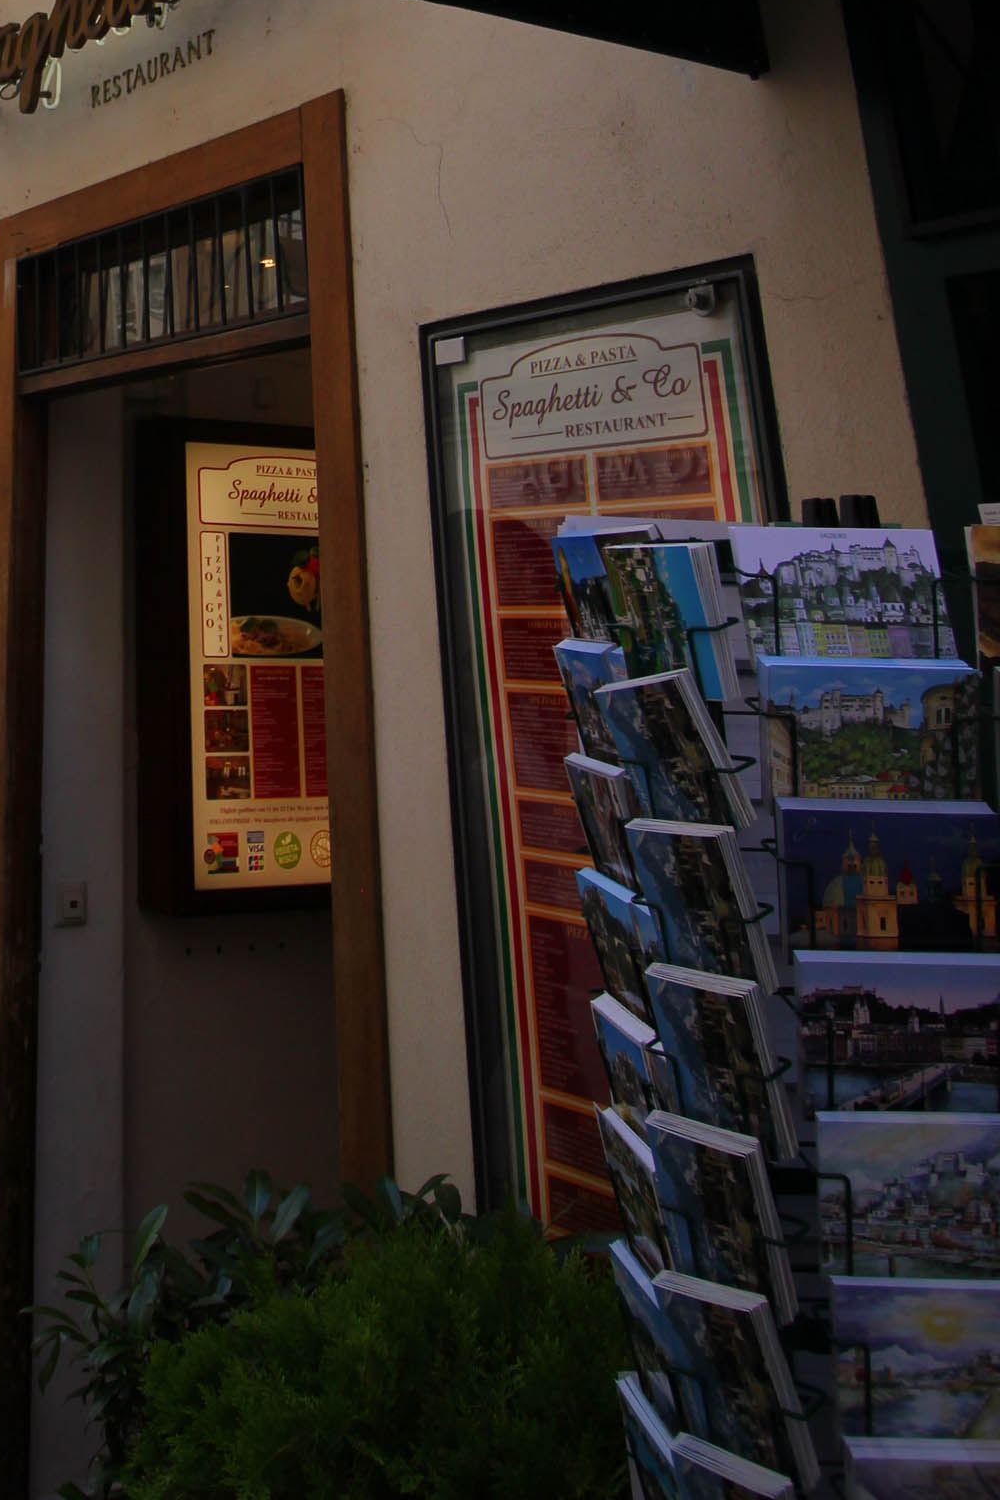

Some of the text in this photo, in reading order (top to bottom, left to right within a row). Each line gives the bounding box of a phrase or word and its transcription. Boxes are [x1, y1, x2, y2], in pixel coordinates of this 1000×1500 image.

[90, 29, 216, 109] RESTAURANT
[529, 345, 637, 375] PIZZA & PASTA
[492, 364, 692, 429] Spaghetti & Co
[564, 412, 668, 438] RESTAURANT
[256, 464, 317, 477] PIZZA & PAST
[228, 479, 303, 508] Spaghetti
[277, 510, 318, 522] RESTAUR
[204, 556, 215, 629] TO GO
